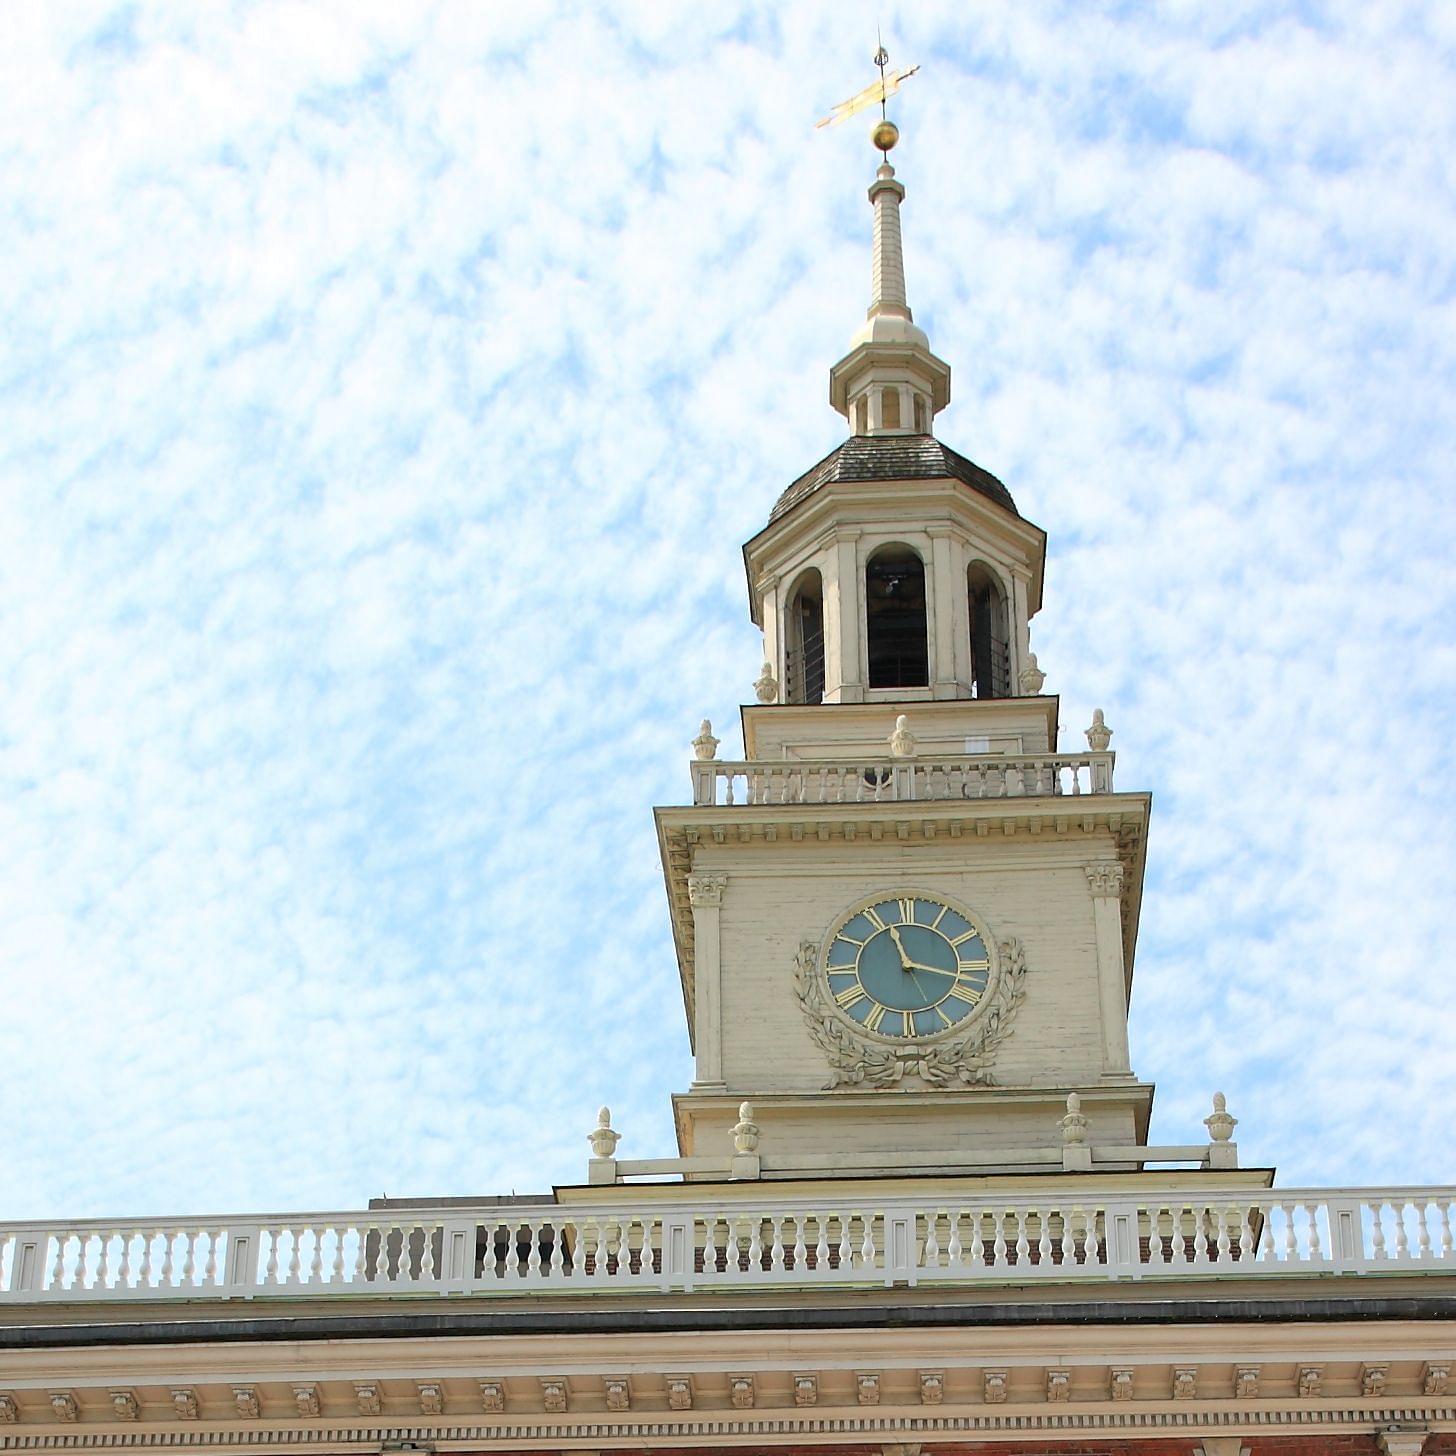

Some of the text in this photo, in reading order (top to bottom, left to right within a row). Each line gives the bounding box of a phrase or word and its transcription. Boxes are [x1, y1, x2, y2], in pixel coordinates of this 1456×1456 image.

[931, 905, 949, 929] I
[950, 928, 978, 947] II
[959, 960, 989, 971] III
